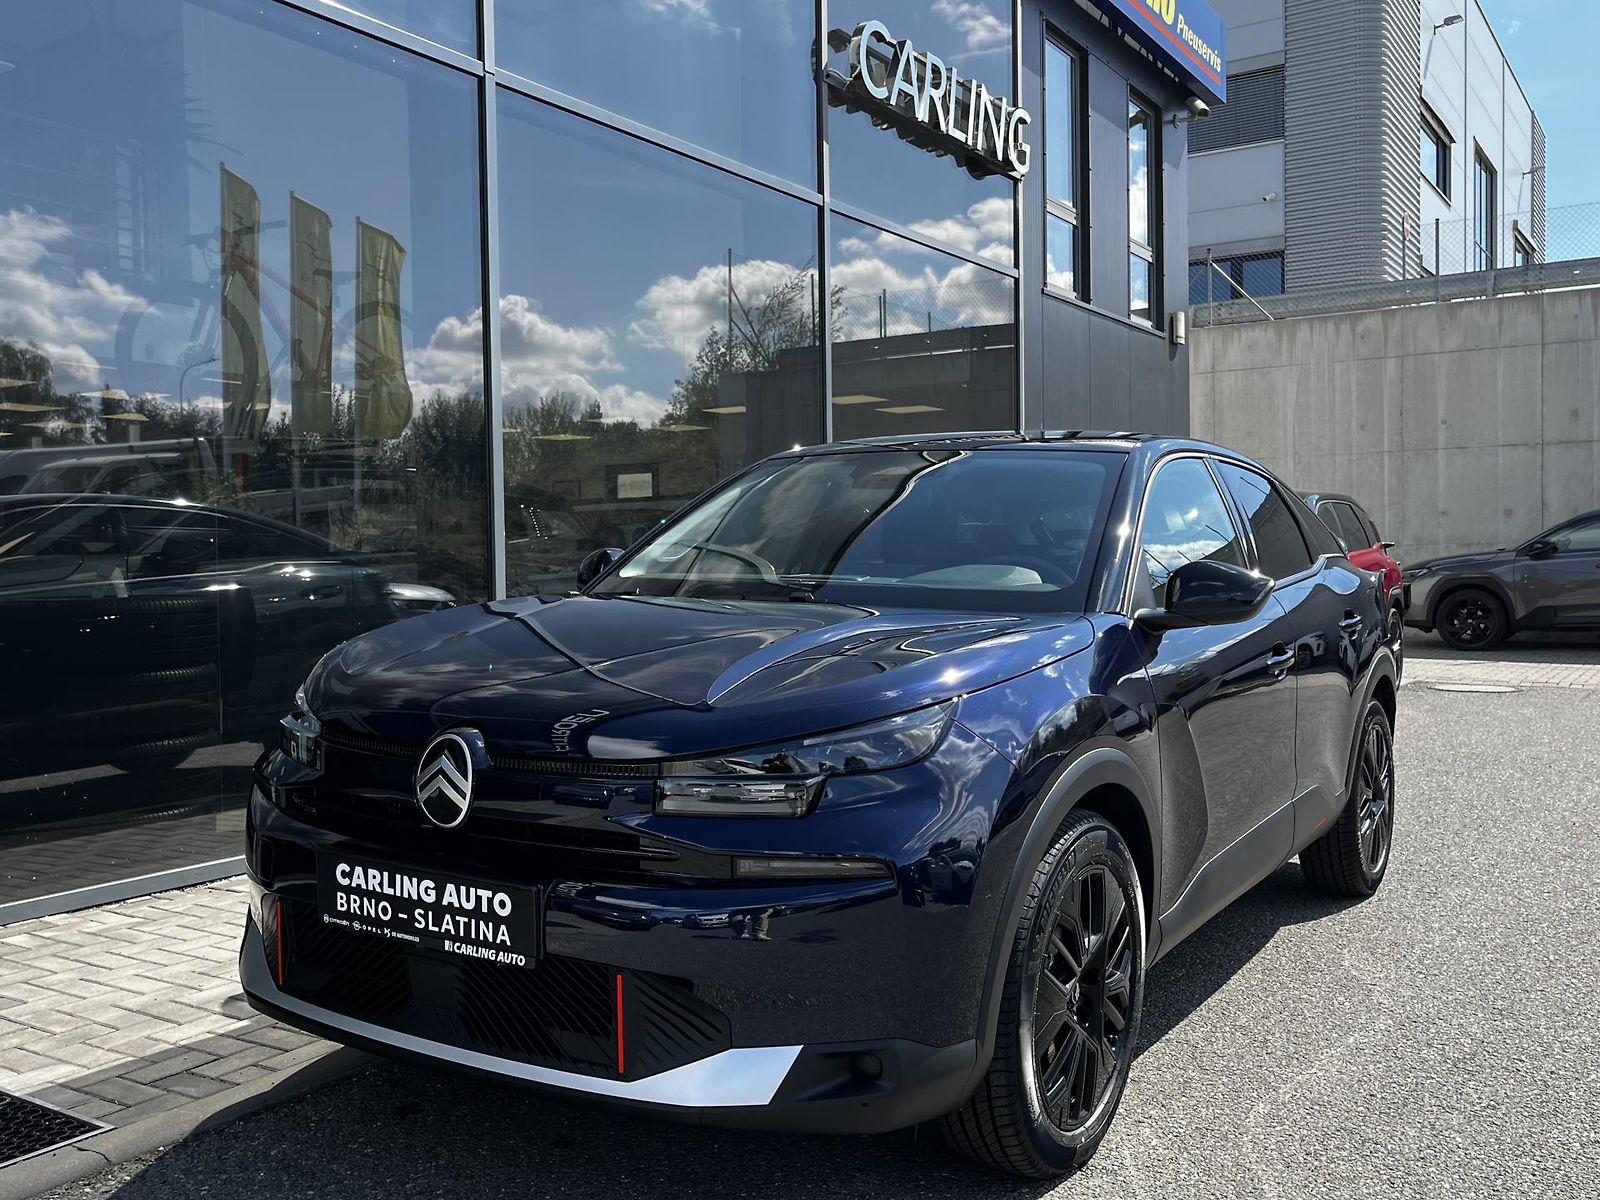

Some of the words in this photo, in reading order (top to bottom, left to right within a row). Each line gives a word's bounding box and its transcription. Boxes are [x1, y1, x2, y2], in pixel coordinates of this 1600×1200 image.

[1177, 13, 1221, 73] Pneuservis
[860, 20, 1031, 174] CARLING
[335, 862, 436, 904] CARLING
[442, 883, 512, 917] AUTO
[336, 891, 392, 921] BRNO
[414, 908, 511, 946] SLATINA
[362, 924, 381, 934] OPEL
[453, 942, 496, 961] CARLING
[497, 951, 526, 967] AUTO
